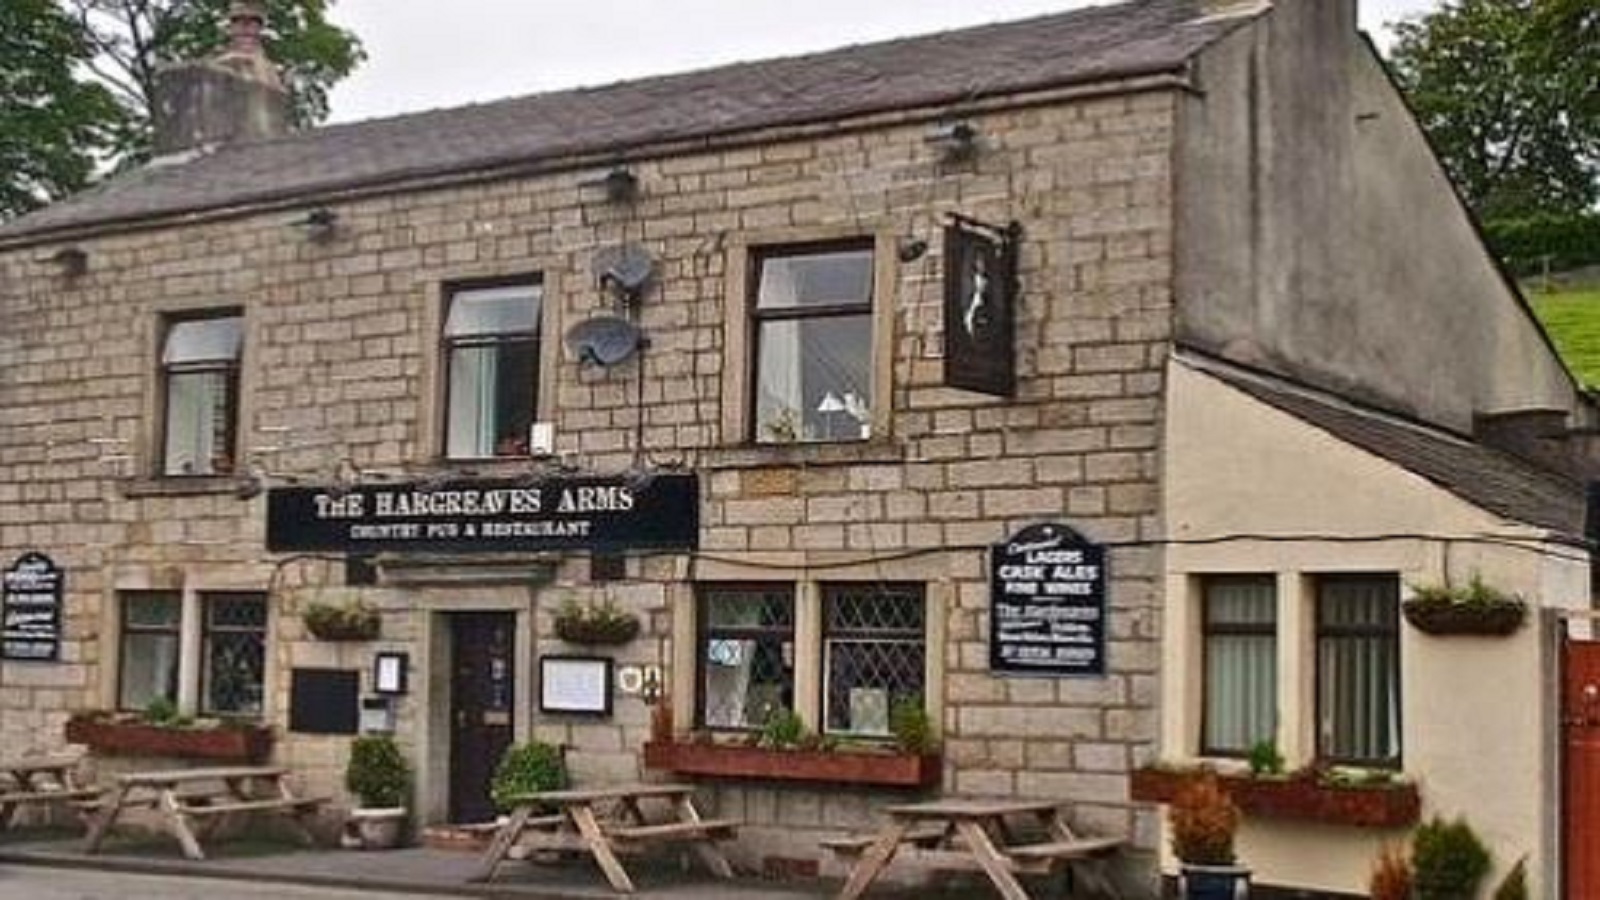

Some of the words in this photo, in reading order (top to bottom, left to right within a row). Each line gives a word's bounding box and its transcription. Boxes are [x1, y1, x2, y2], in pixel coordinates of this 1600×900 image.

[314, 493, 364, 518] THE
[375, 489, 541, 515] HARGREAVES
[557, 486, 633, 512] ARMS
[1052, 565, 1098, 581] ALES
